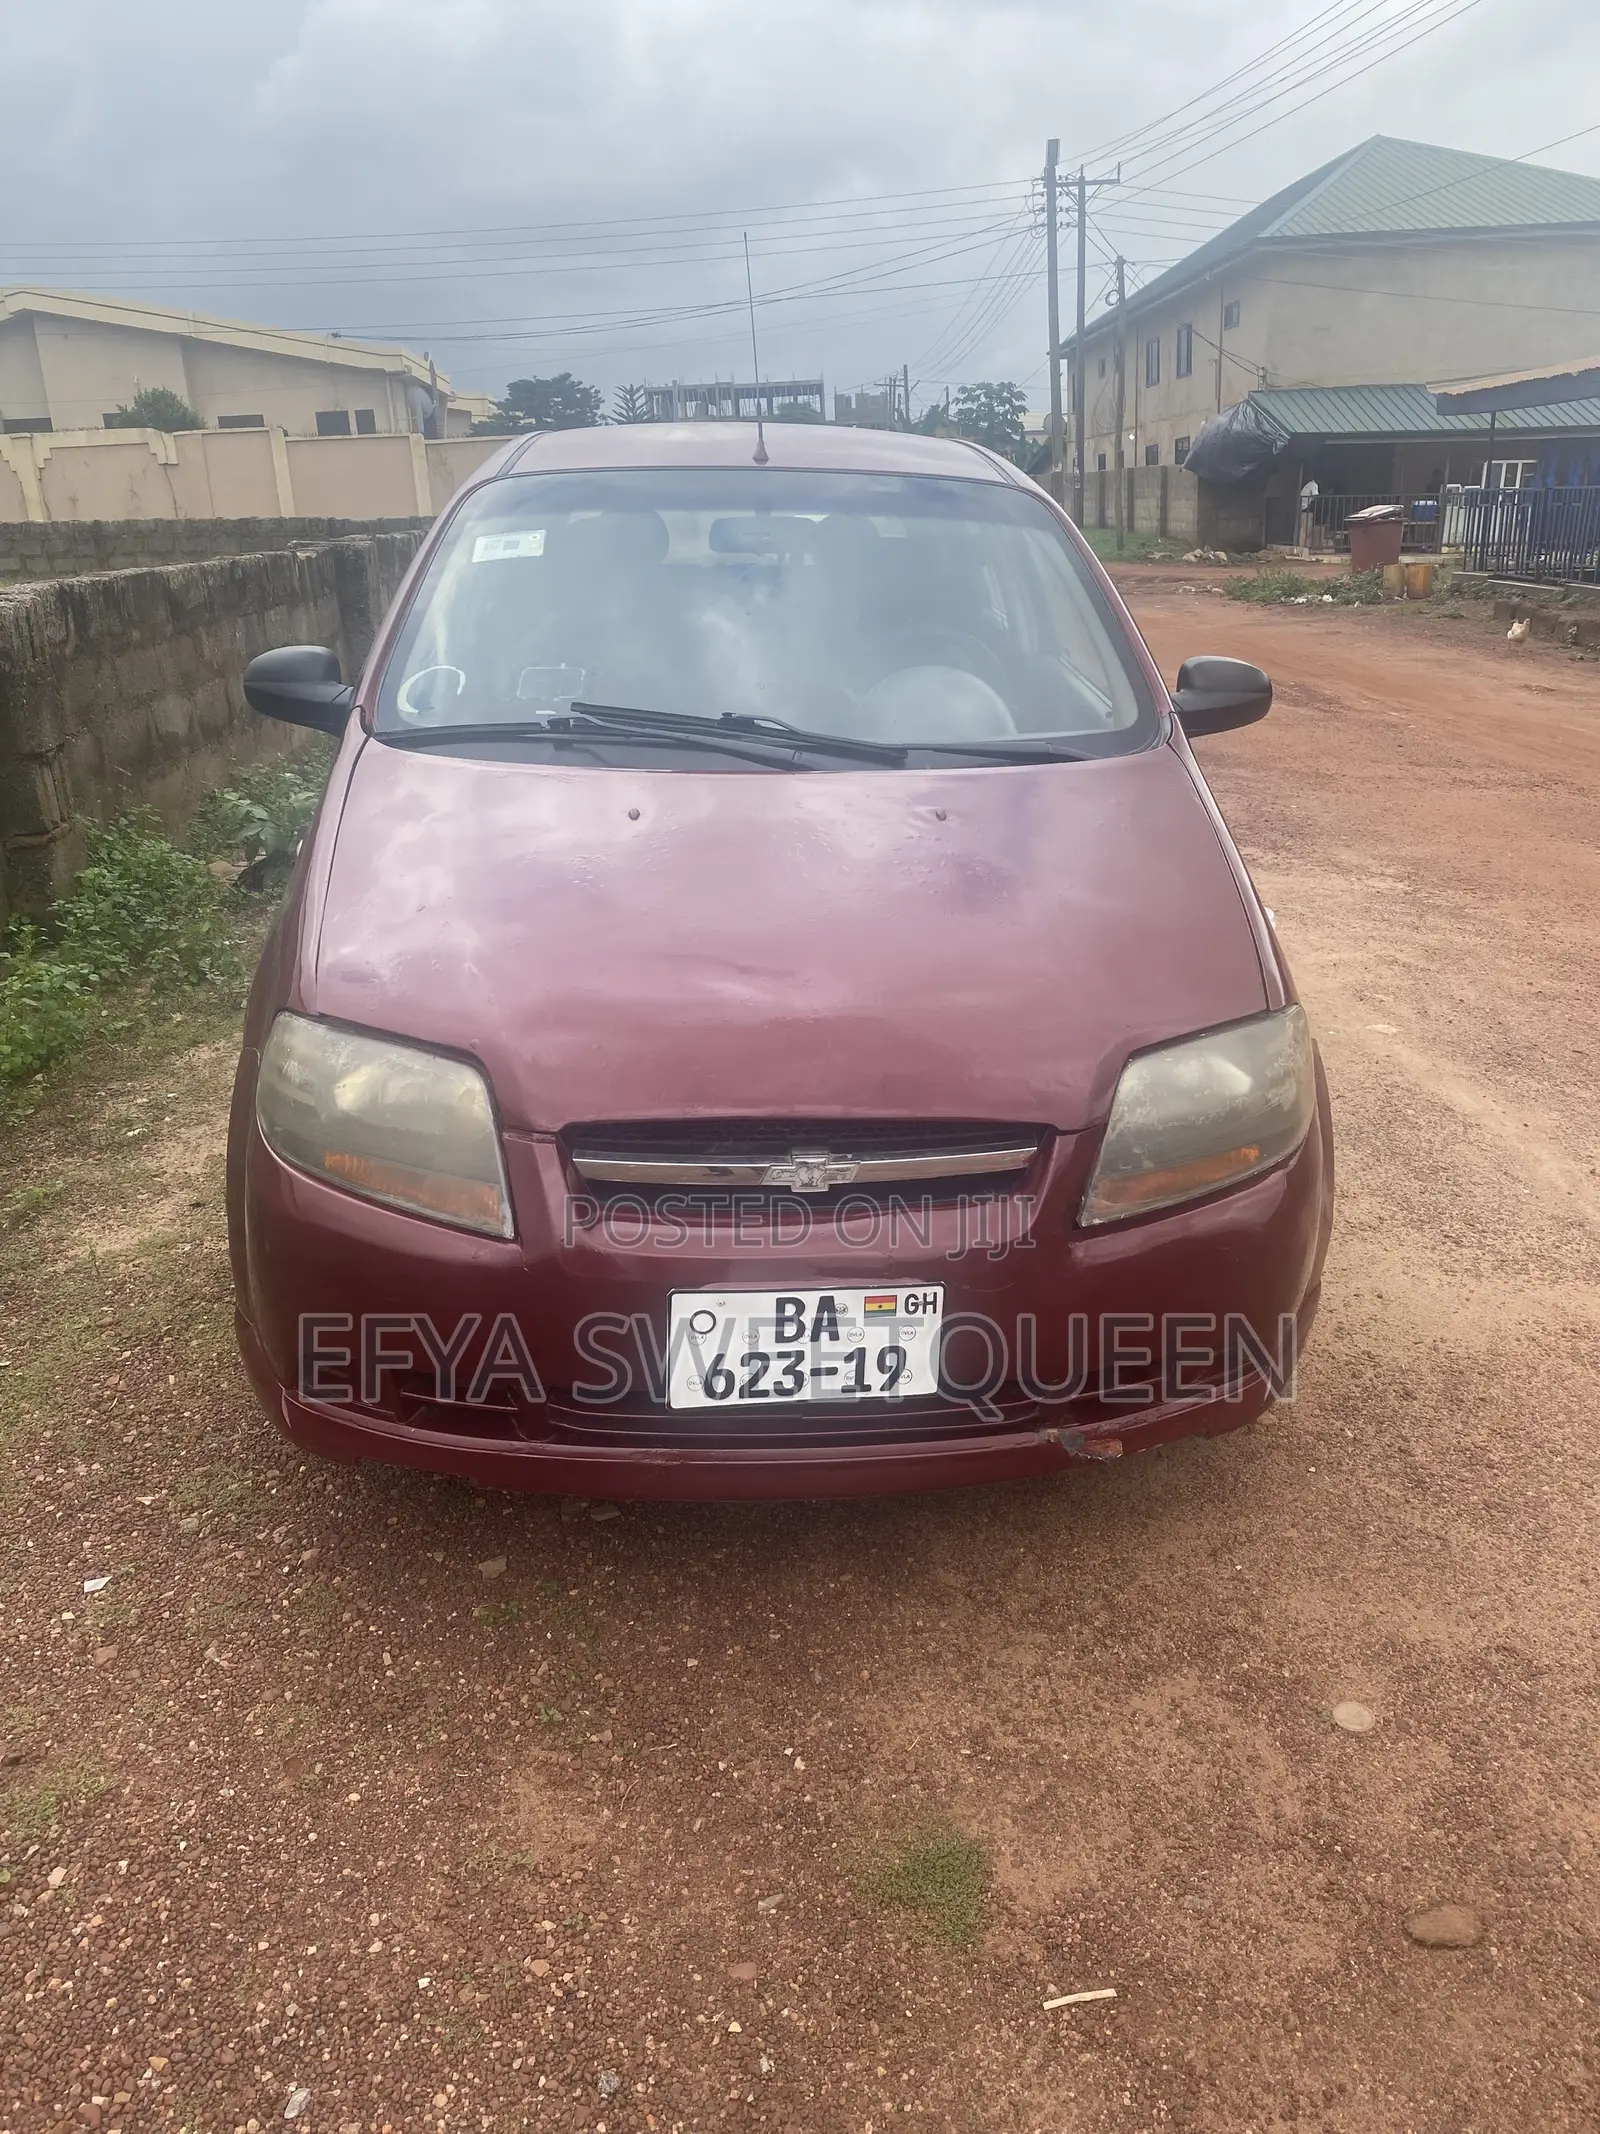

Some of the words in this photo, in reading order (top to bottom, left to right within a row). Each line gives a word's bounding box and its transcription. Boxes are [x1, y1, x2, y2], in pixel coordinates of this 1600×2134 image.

[774, 1295, 840, 1343] BA
[904, 1292, 938, 1316] GH
[704, 1345, 907, 1400] 623-19
